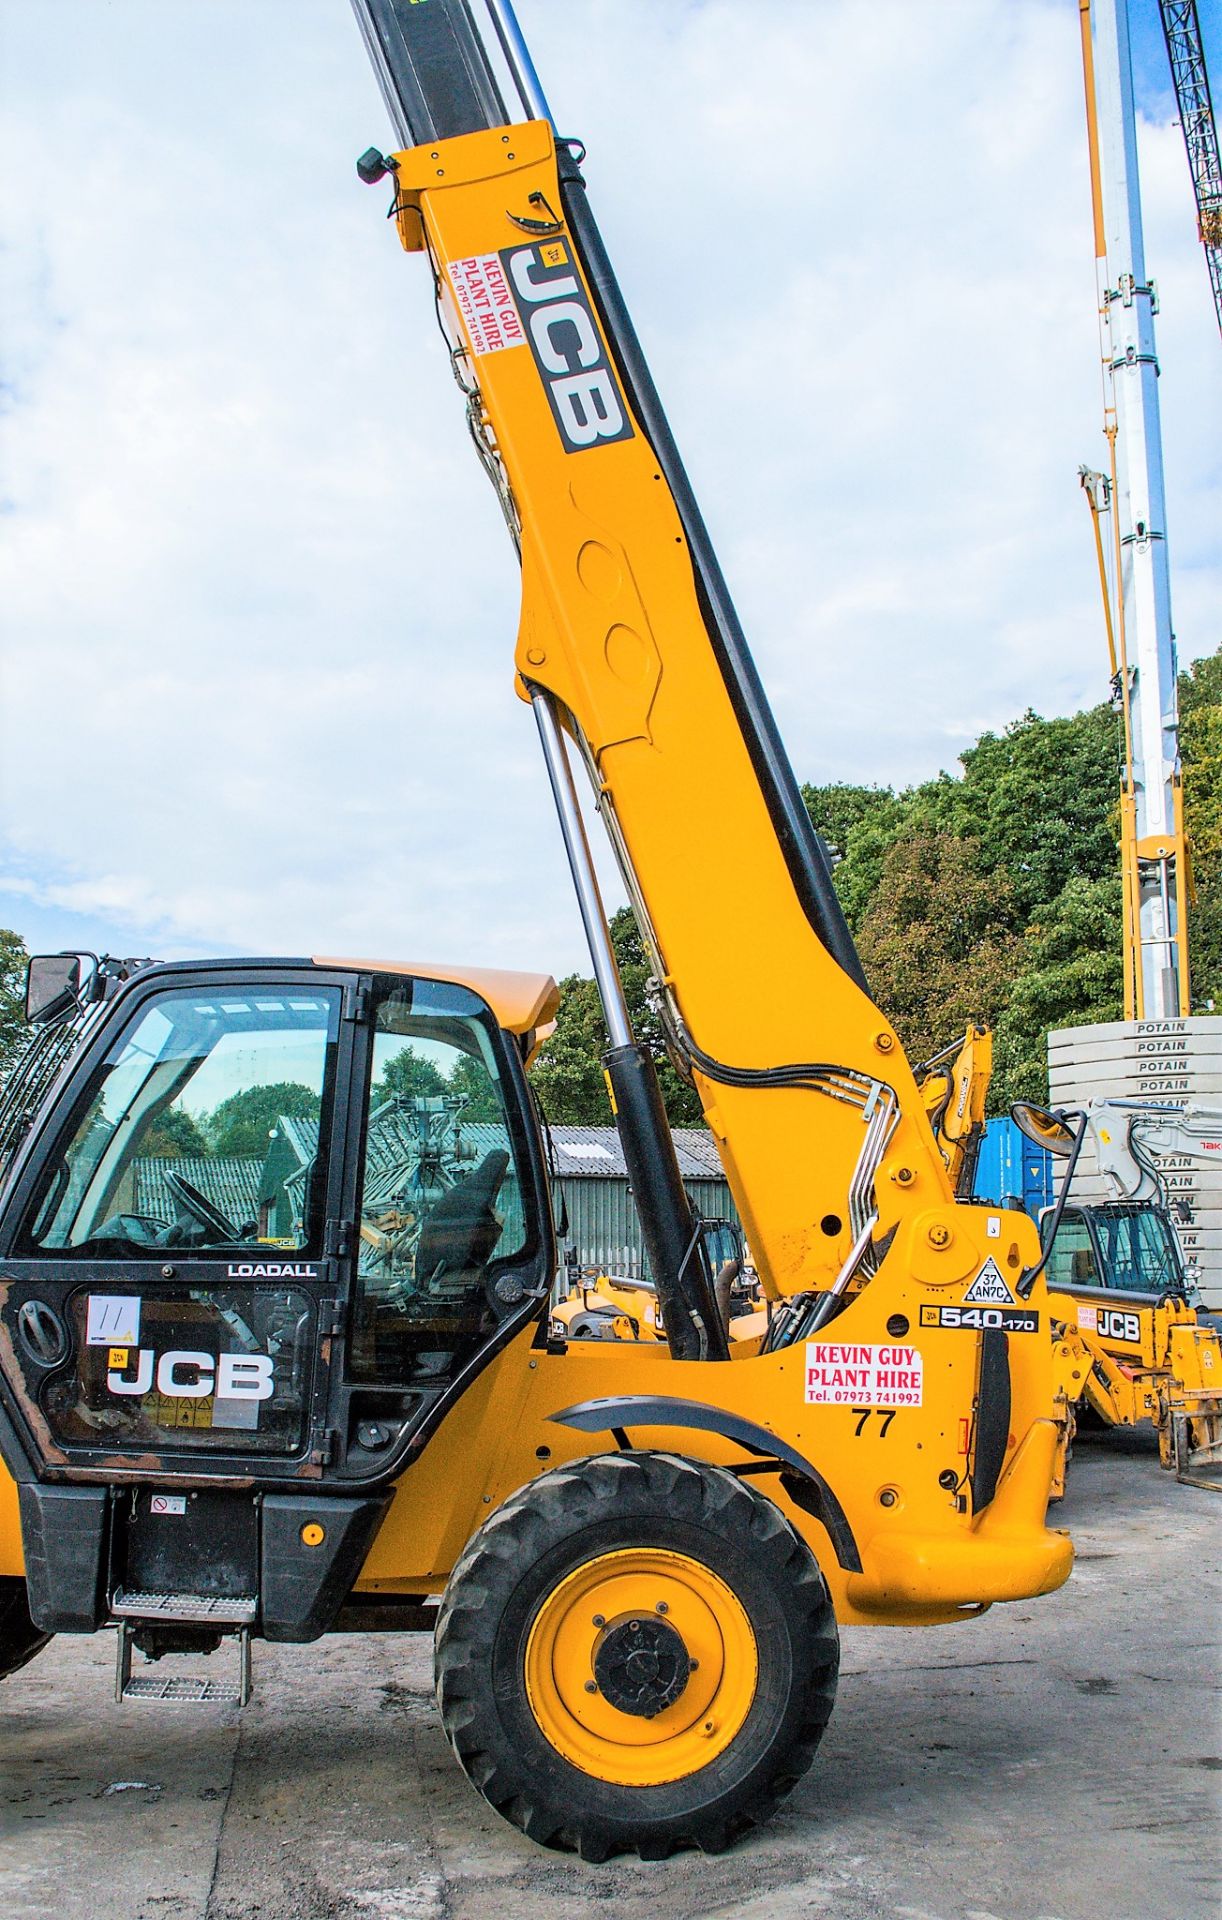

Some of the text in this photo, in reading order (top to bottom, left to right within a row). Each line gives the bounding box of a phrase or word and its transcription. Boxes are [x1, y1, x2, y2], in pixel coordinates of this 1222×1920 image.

[461, 258, 505, 351] PLANT HIRE
[482, 259, 523, 339] KEVIN GUY
[456, 284, 473, 315] 07973
[467, 317, 486, 354] 741992
[510, 248, 623, 445] JCB
[1137, 1022, 1186, 1033] POTAIN
[1138, 1041, 1186, 1052] POTAIN
[1139, 1060, 1188, 1072] POTAIN
[1140, 1080, 1189, 1091] POTAIN
[1152, 1158, 1192, 1167] OTAIN
[227, 1264, 318, 1277] LOADALL
[983, 1274, 997, 1286] 37
[975, 1286, 1004, 1298] AN7C
[1097, 1311, 1140, 1341] JCB
[815, 1345, 914, 1365] KEVIN GUY
[107, 1349, 275, 1400] JCB
[808, 1368, 921, 1388] PLANT HIRE
[808, 1390, 920, 1404] Tel. 07973 741992
[851, 1407, 897, 1438] 77
